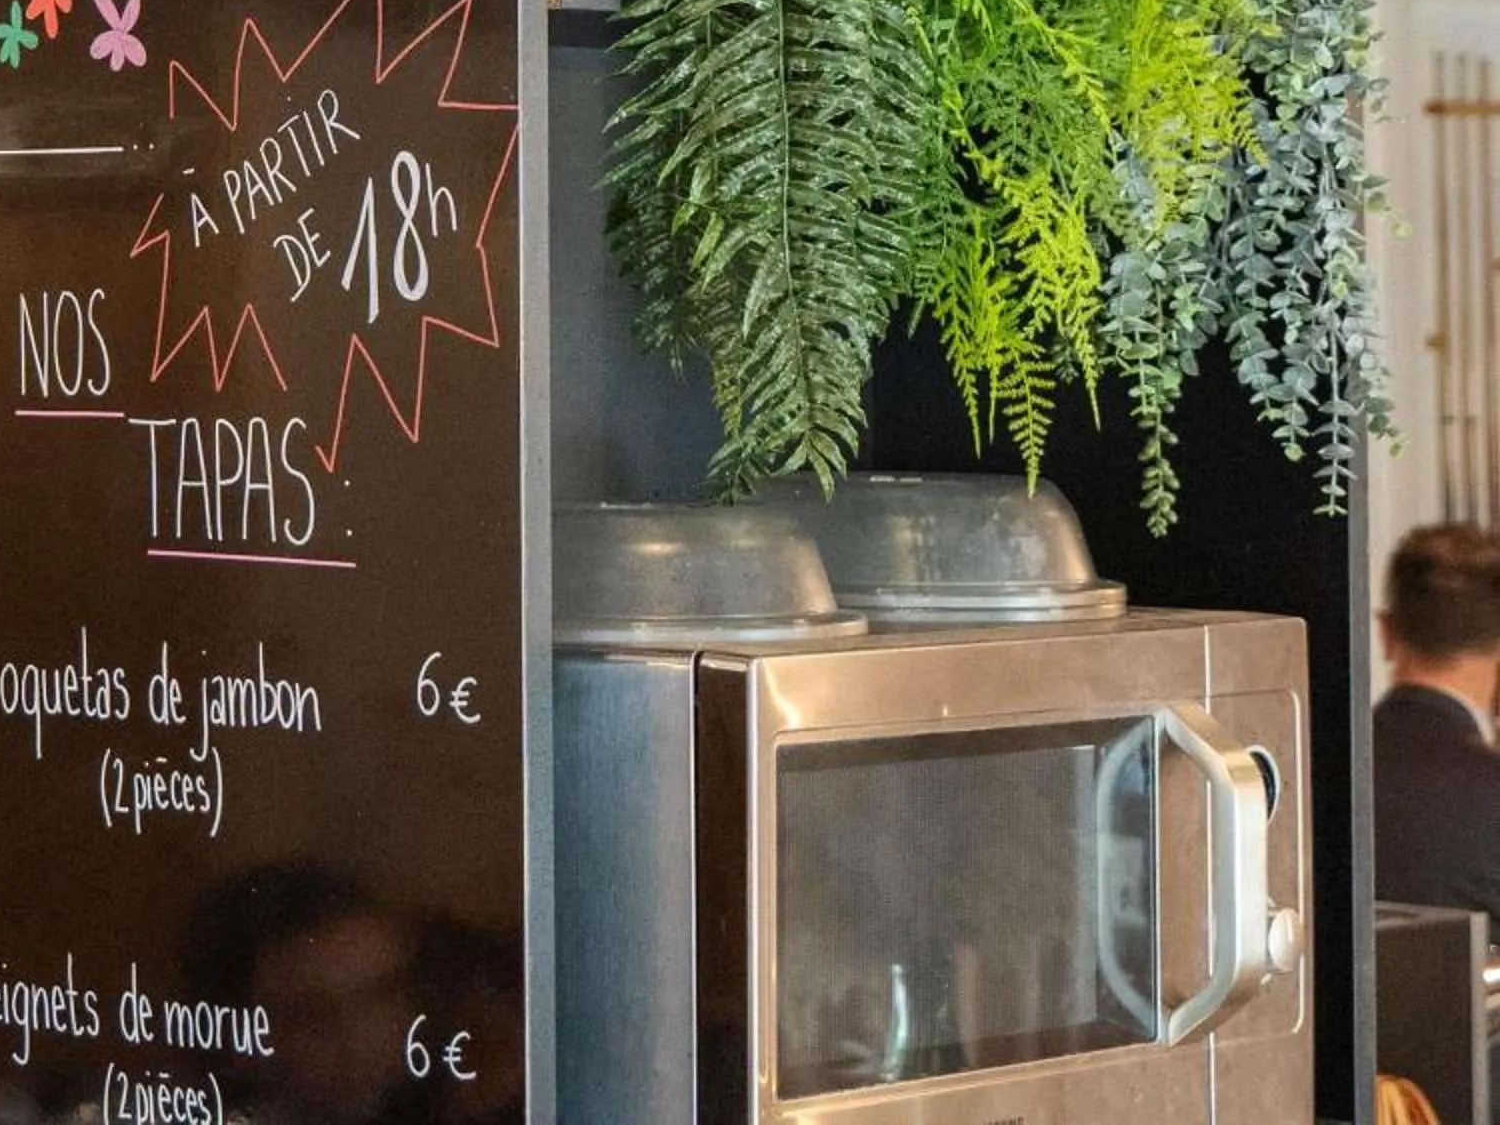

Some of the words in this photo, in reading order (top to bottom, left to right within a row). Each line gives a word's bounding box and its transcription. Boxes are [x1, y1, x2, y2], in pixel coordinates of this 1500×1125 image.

[224, 89, 360, 233] PARTIR
[274, 208, 331, 301] DE
[341, 151, 458, 323] 18h
[19, 289, 111, 397] NOS
[149, 641, 187, 725] de
[189, 641, 322, 761] jambon
[119, 962, 153, 1043] de
[164, 1002, 275, 1057] morue
